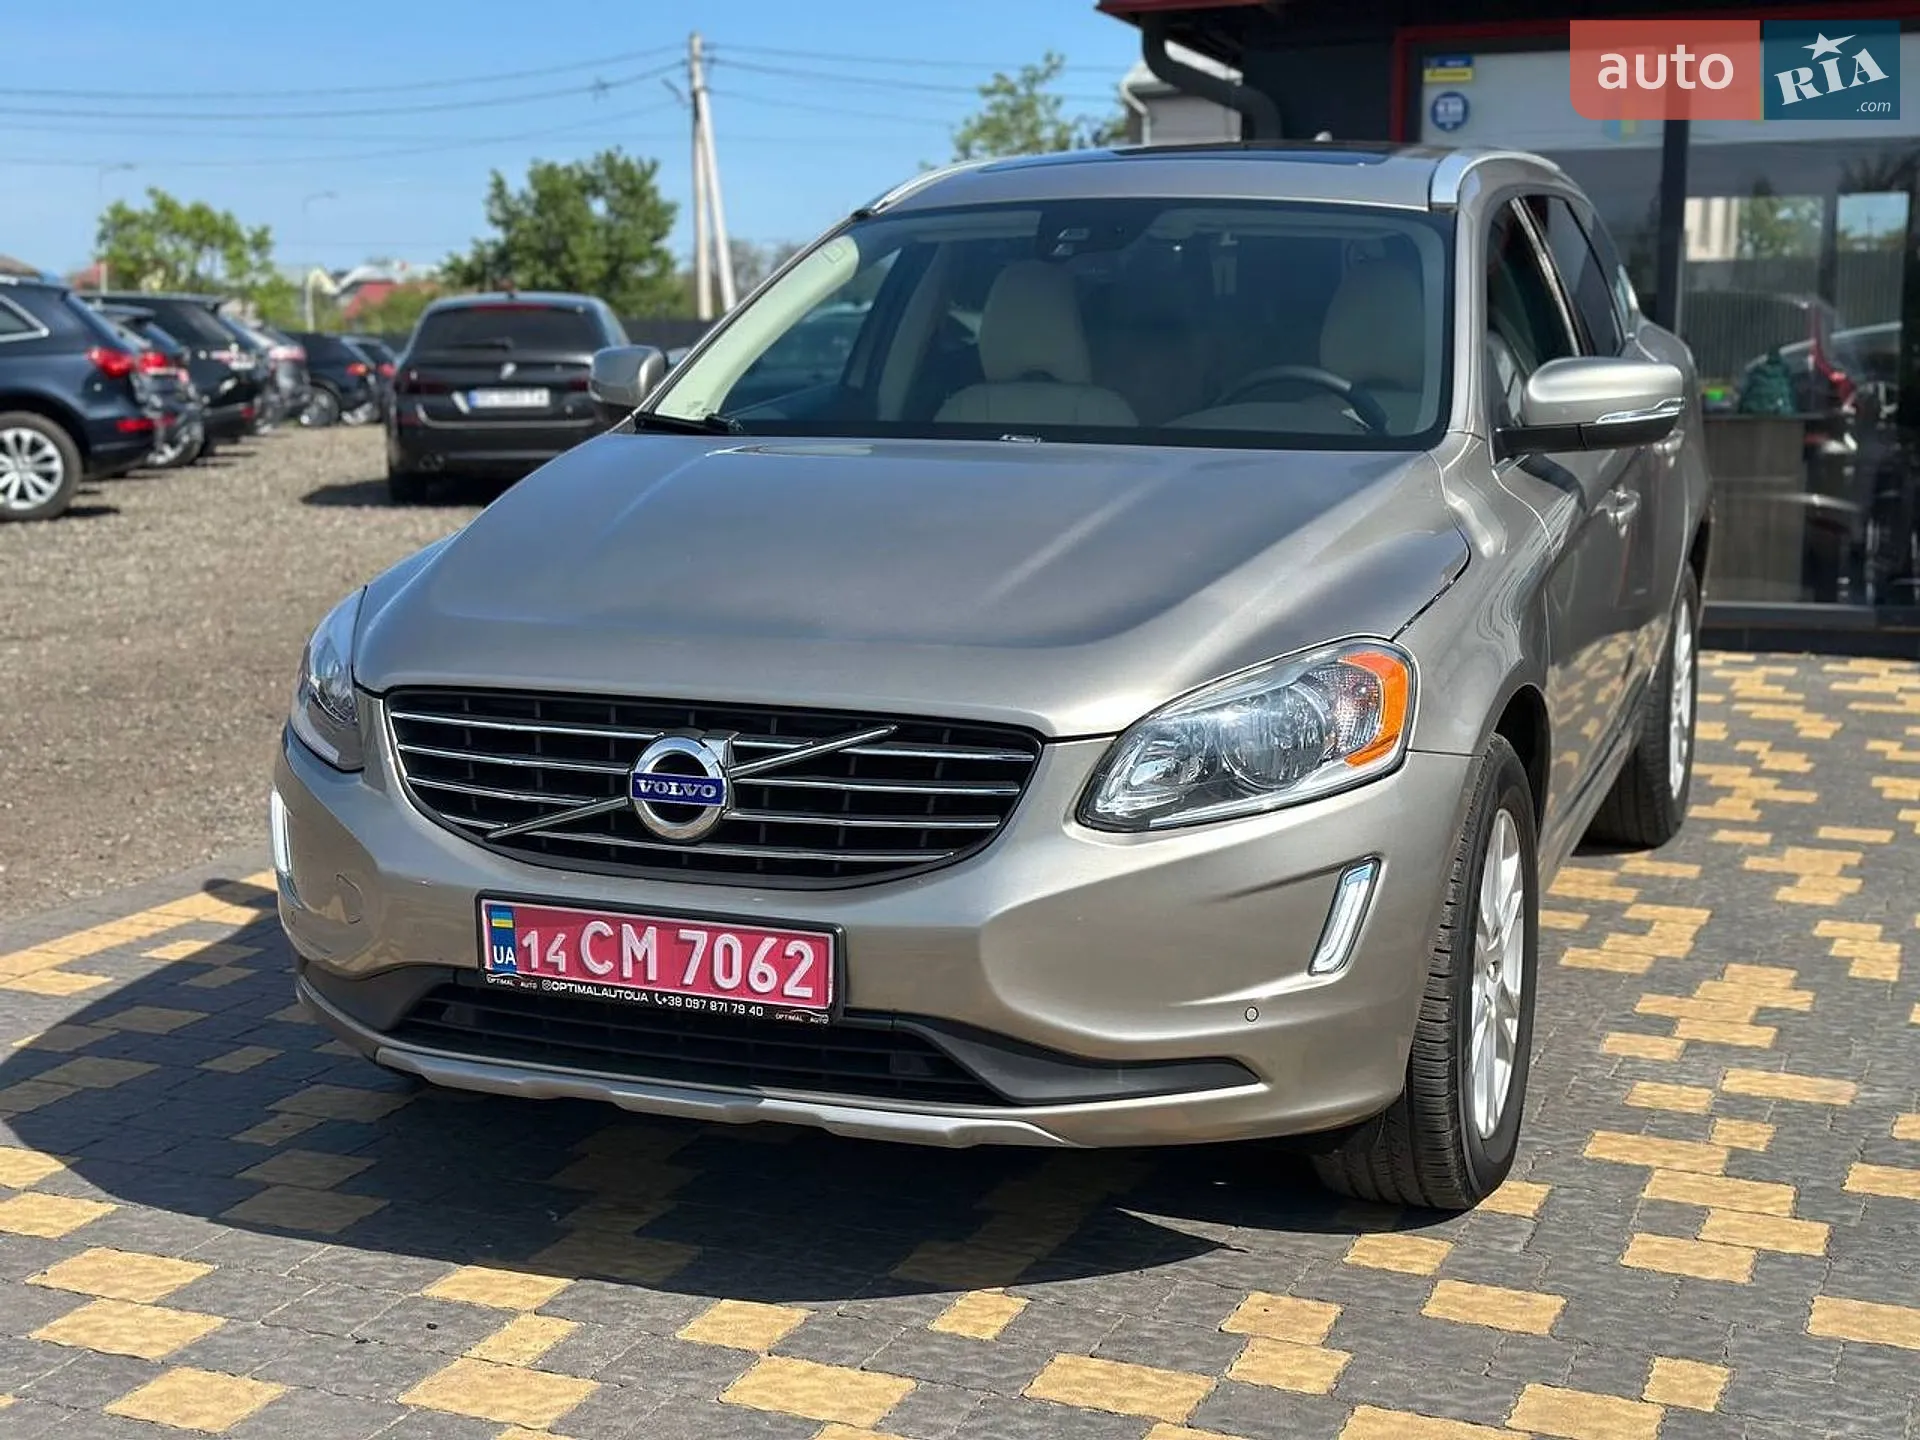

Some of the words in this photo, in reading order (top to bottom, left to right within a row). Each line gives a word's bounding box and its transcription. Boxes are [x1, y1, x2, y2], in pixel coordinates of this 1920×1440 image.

[636, 779, 717, 798] VOLVO
[493, 945, 517, 966] UA
[522, 930, 567, 973] 14
[580, 920, 657, 981] CM
[678, 928, 814, 999] 7062
[685, 997, 707, 1010] 097
[709, 1000, 728, 1012] 871
[732, 1003, 746, 1014] 79
[749, 1005, 764, 1017] 40
